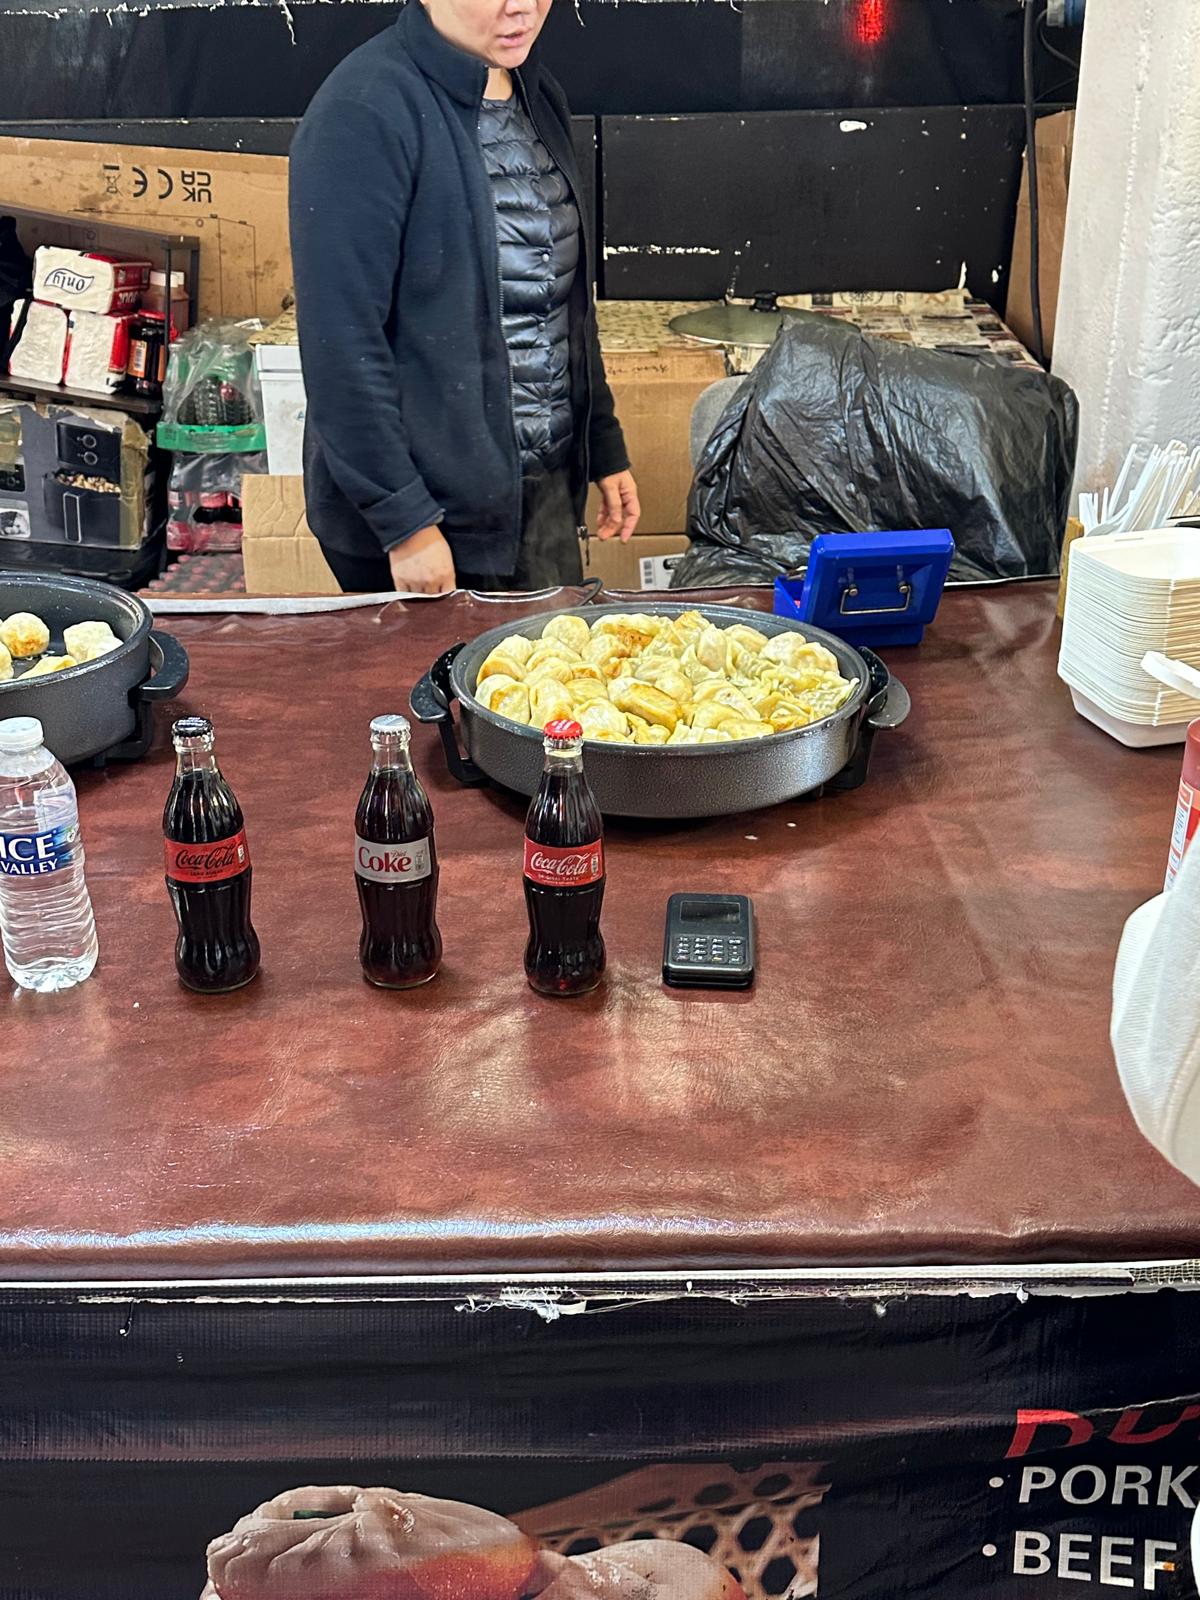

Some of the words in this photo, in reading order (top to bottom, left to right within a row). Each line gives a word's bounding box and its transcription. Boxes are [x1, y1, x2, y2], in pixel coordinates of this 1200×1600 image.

[132, 167, 174, 200] CE
[180, 170, 212, 187] CA
[182, 187, 212, 204] UK
[52, 271, 86, 291] Only
[0, 834, 55, 861] ICE
[358, 846, 412, 873] Coke
[0, 858, 58, 875] VALLEY
[1018, 1464, 1199, 1509] PORK
[1013, 1530, 1178, 1591] BEEF
